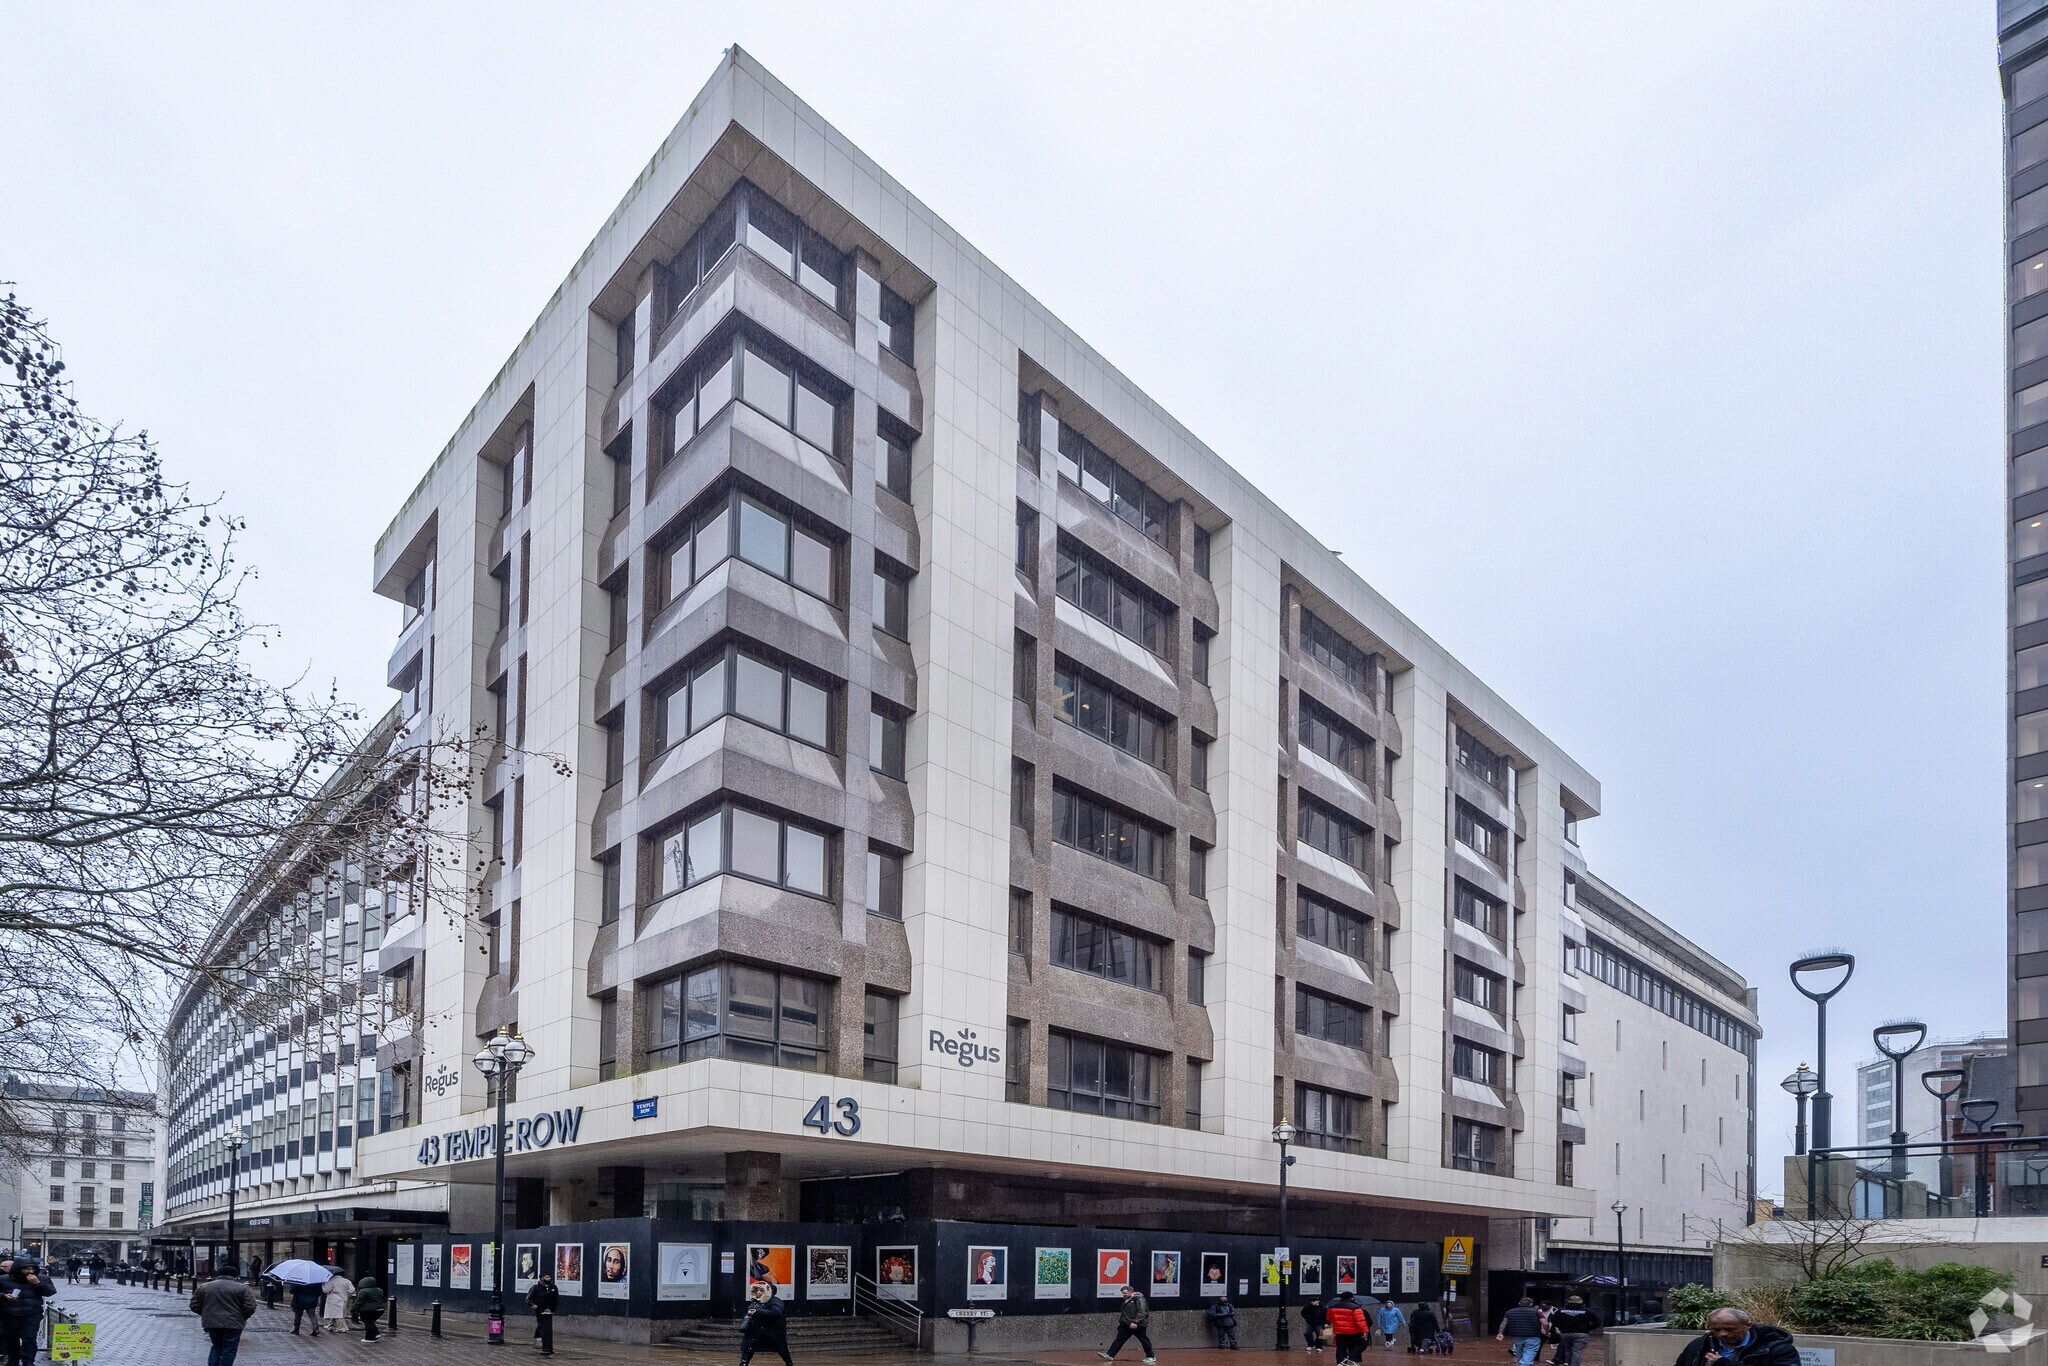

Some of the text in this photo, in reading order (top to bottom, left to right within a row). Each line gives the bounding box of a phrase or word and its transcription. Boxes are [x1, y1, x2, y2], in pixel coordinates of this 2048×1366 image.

[929, 1028, 1000, 1067] Regus
[424, 1064, 459, 1096] Regus
[417, 1106, 583, 1165] 43 TEMPLE ROW
[803, 1095, 861, 1136] 43
